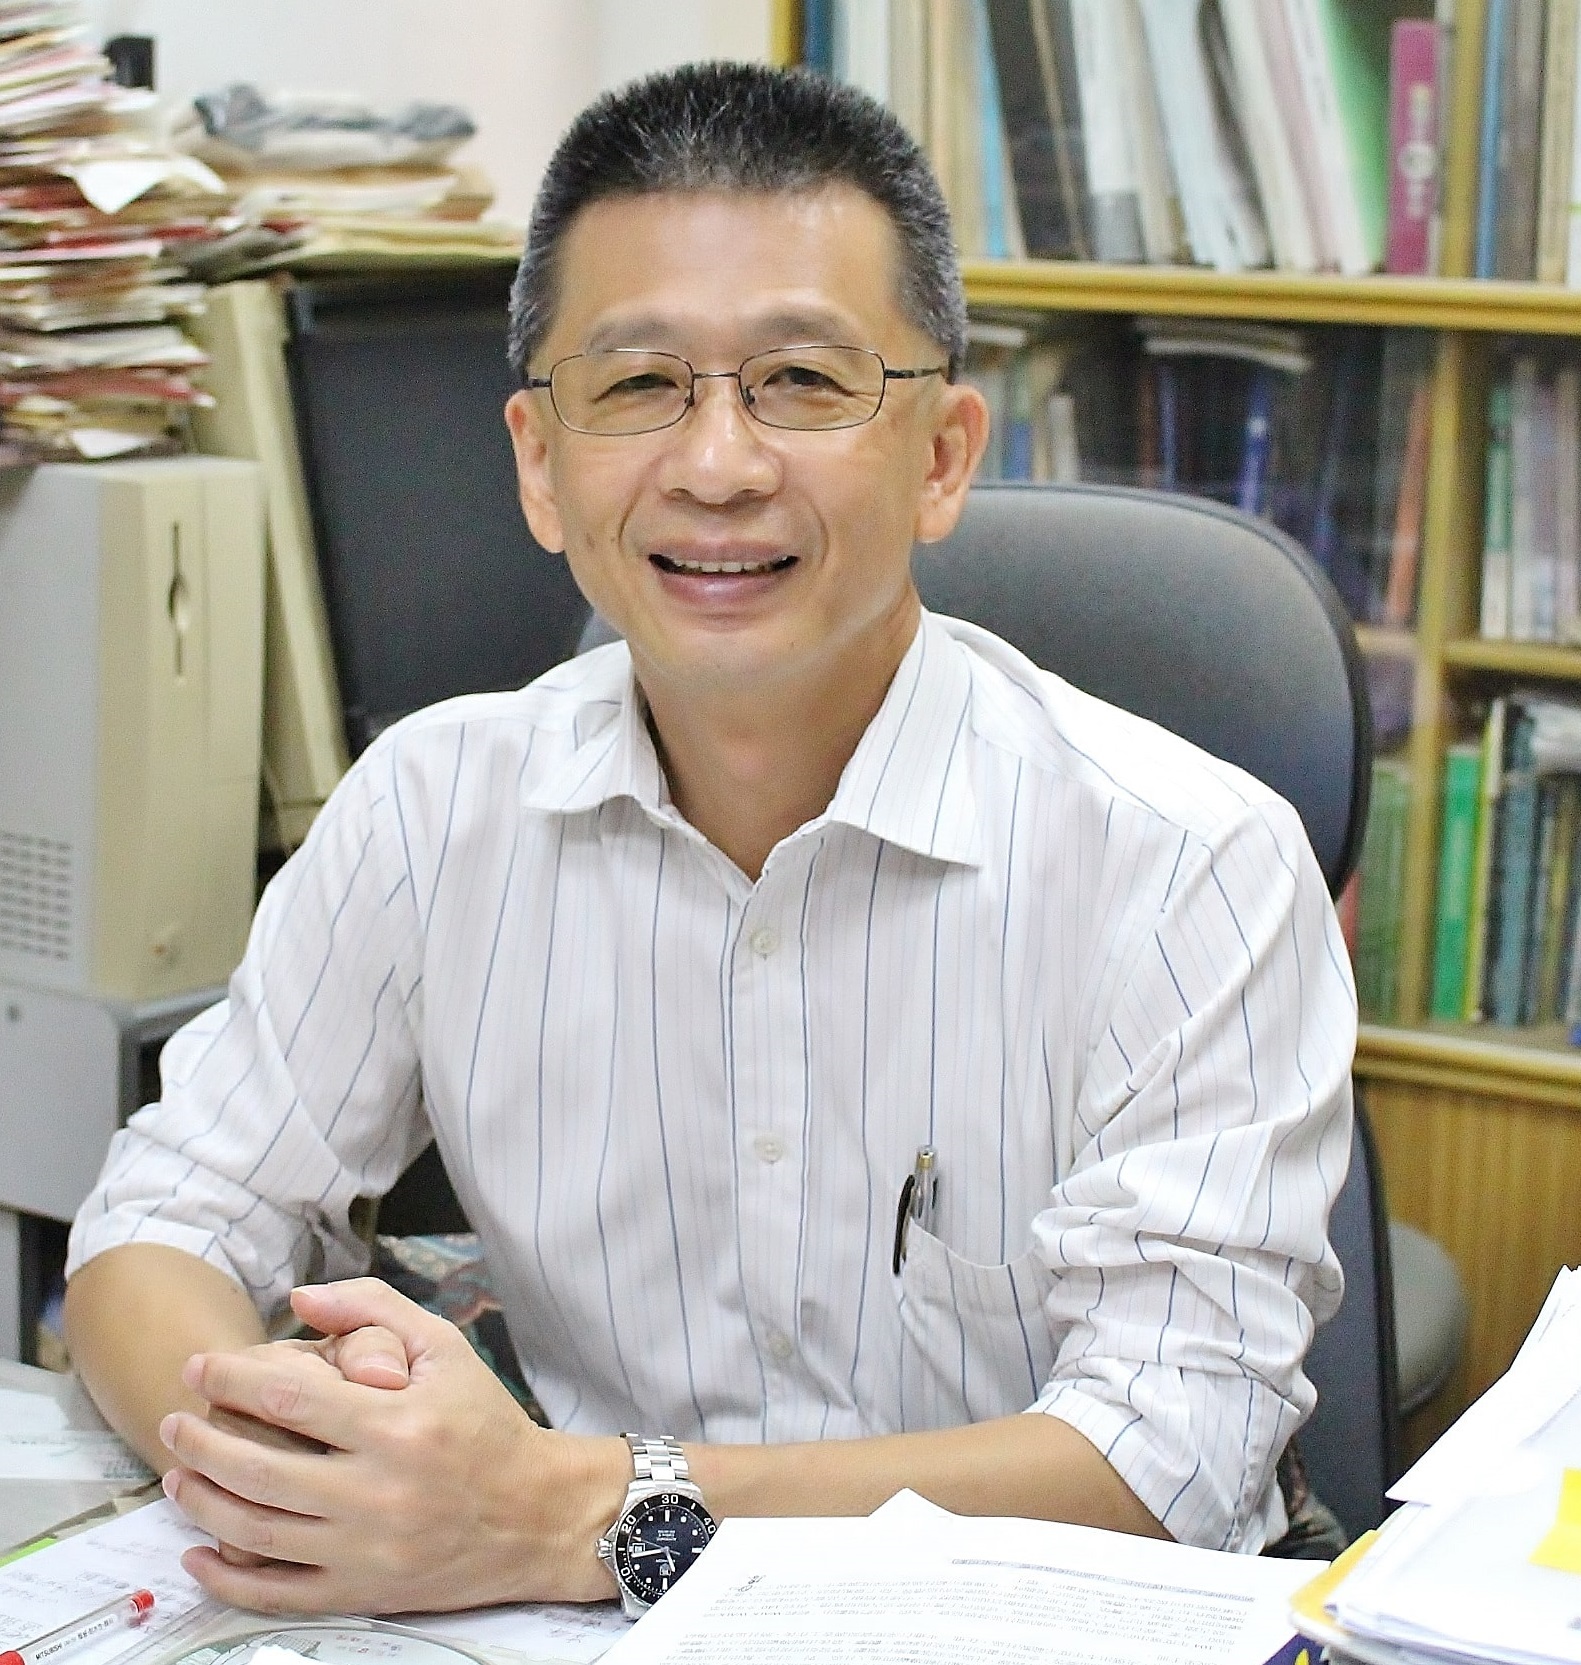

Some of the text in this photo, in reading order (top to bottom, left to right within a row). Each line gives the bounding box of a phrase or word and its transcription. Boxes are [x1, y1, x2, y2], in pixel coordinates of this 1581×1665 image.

[661, 1494, 679, 1504] 30
[621, 1515, 637, 1533] 20
[703, 1517, 717, 1535] 40
[620, 1566, 633, 1583] 10
